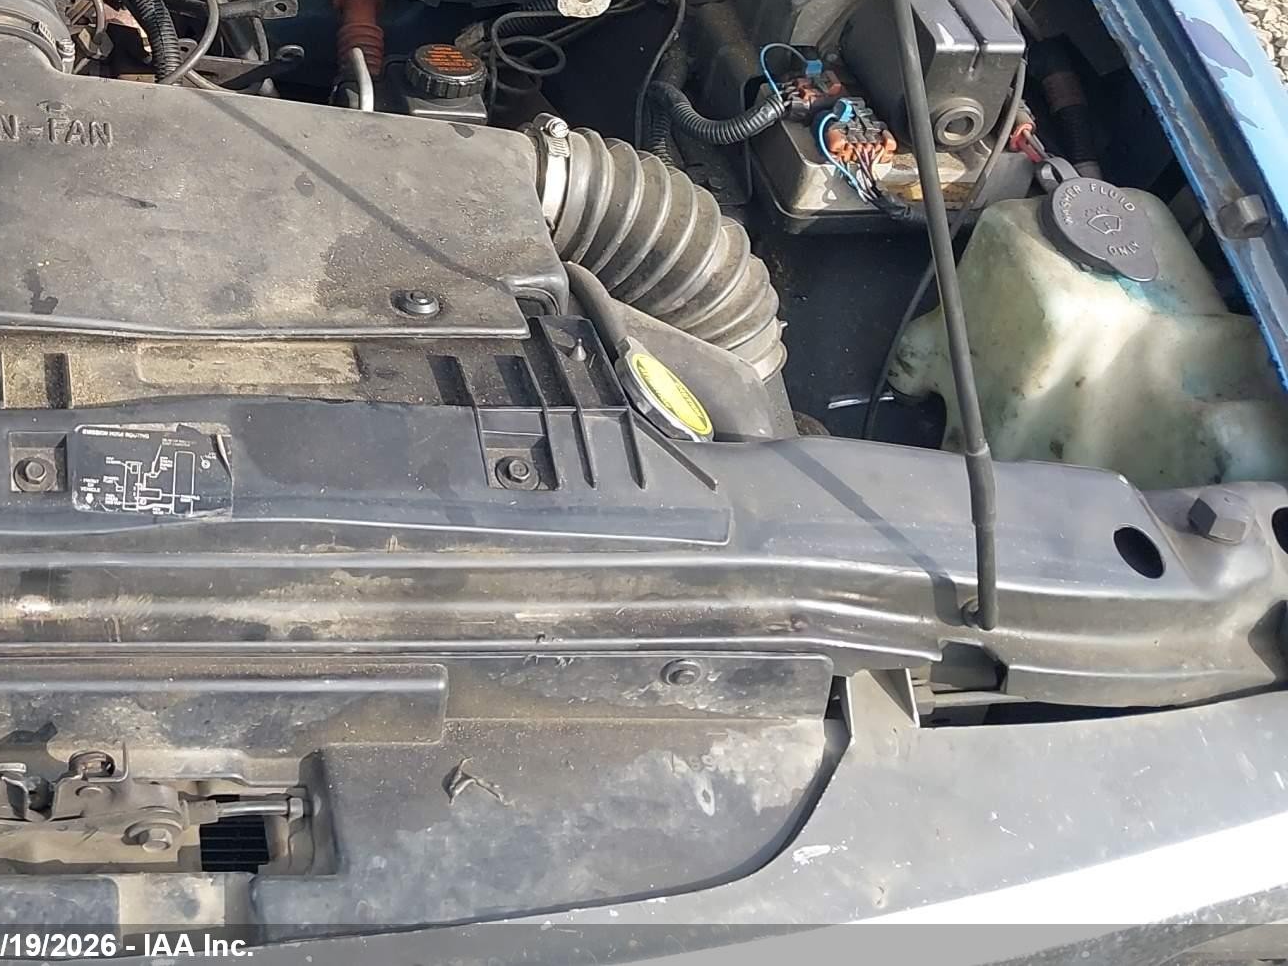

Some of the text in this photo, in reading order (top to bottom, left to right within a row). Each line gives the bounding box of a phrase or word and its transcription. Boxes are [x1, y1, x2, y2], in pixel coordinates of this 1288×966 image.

[47, 117, 114, 147] FAN
[1059, 183, 1136, 225] WASHER FLUID
[1107, 241, 1141, 256] ONLY
